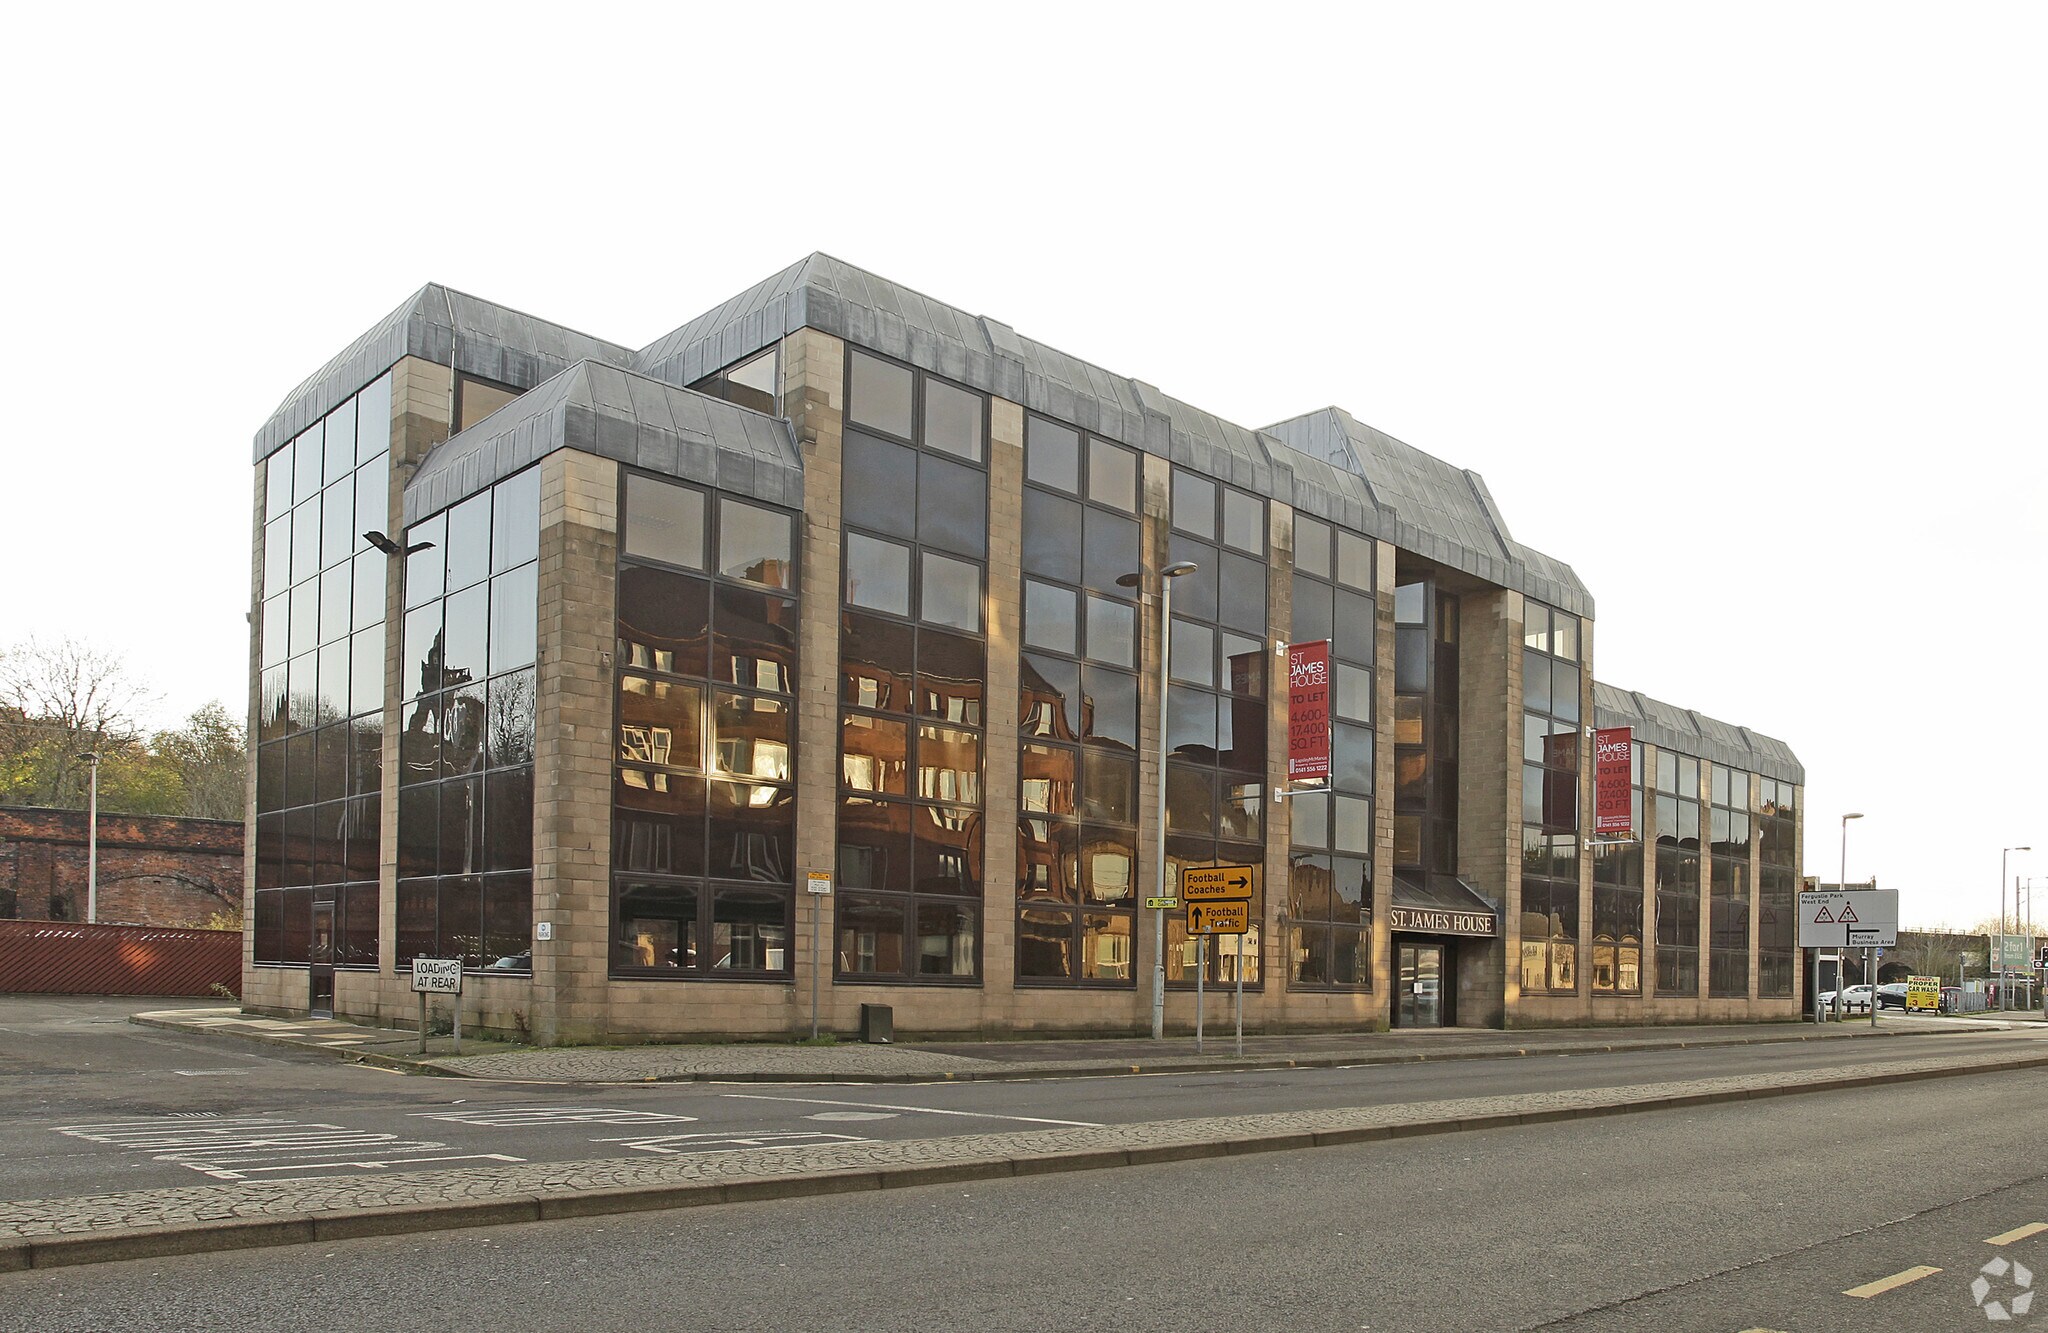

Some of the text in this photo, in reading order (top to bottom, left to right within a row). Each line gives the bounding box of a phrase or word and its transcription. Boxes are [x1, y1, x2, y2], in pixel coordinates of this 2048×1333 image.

[1290, 652, 1304, 665] ST
[1290, 661, 1324, 676] JAMES
[1290, 672, 1326, 688] HOUSE
[1291, 691, 1325, 704] TO LET
[1291, 736, 1325, 750] SQ FT
[1597, 735, 1610, 744] ST
[1597, 742, 1628, 754] JAMES
[1597, 751, 1630, 762] HOUSE
[1599, 766, 1628, 775] TO LET
[1598, 799, 1628, 810] SQ FT
[1187, 873, 1225, 883] Football
[1187, 885, 1225, 894] Coaches
[1206, 907, 1243, 916] Football
[1210, 919, 1240, 928] Traffic
[1391, 910, 1492, 933] ST. JAMES HOUSE
[417, 977, 456, 989] AT REAR
